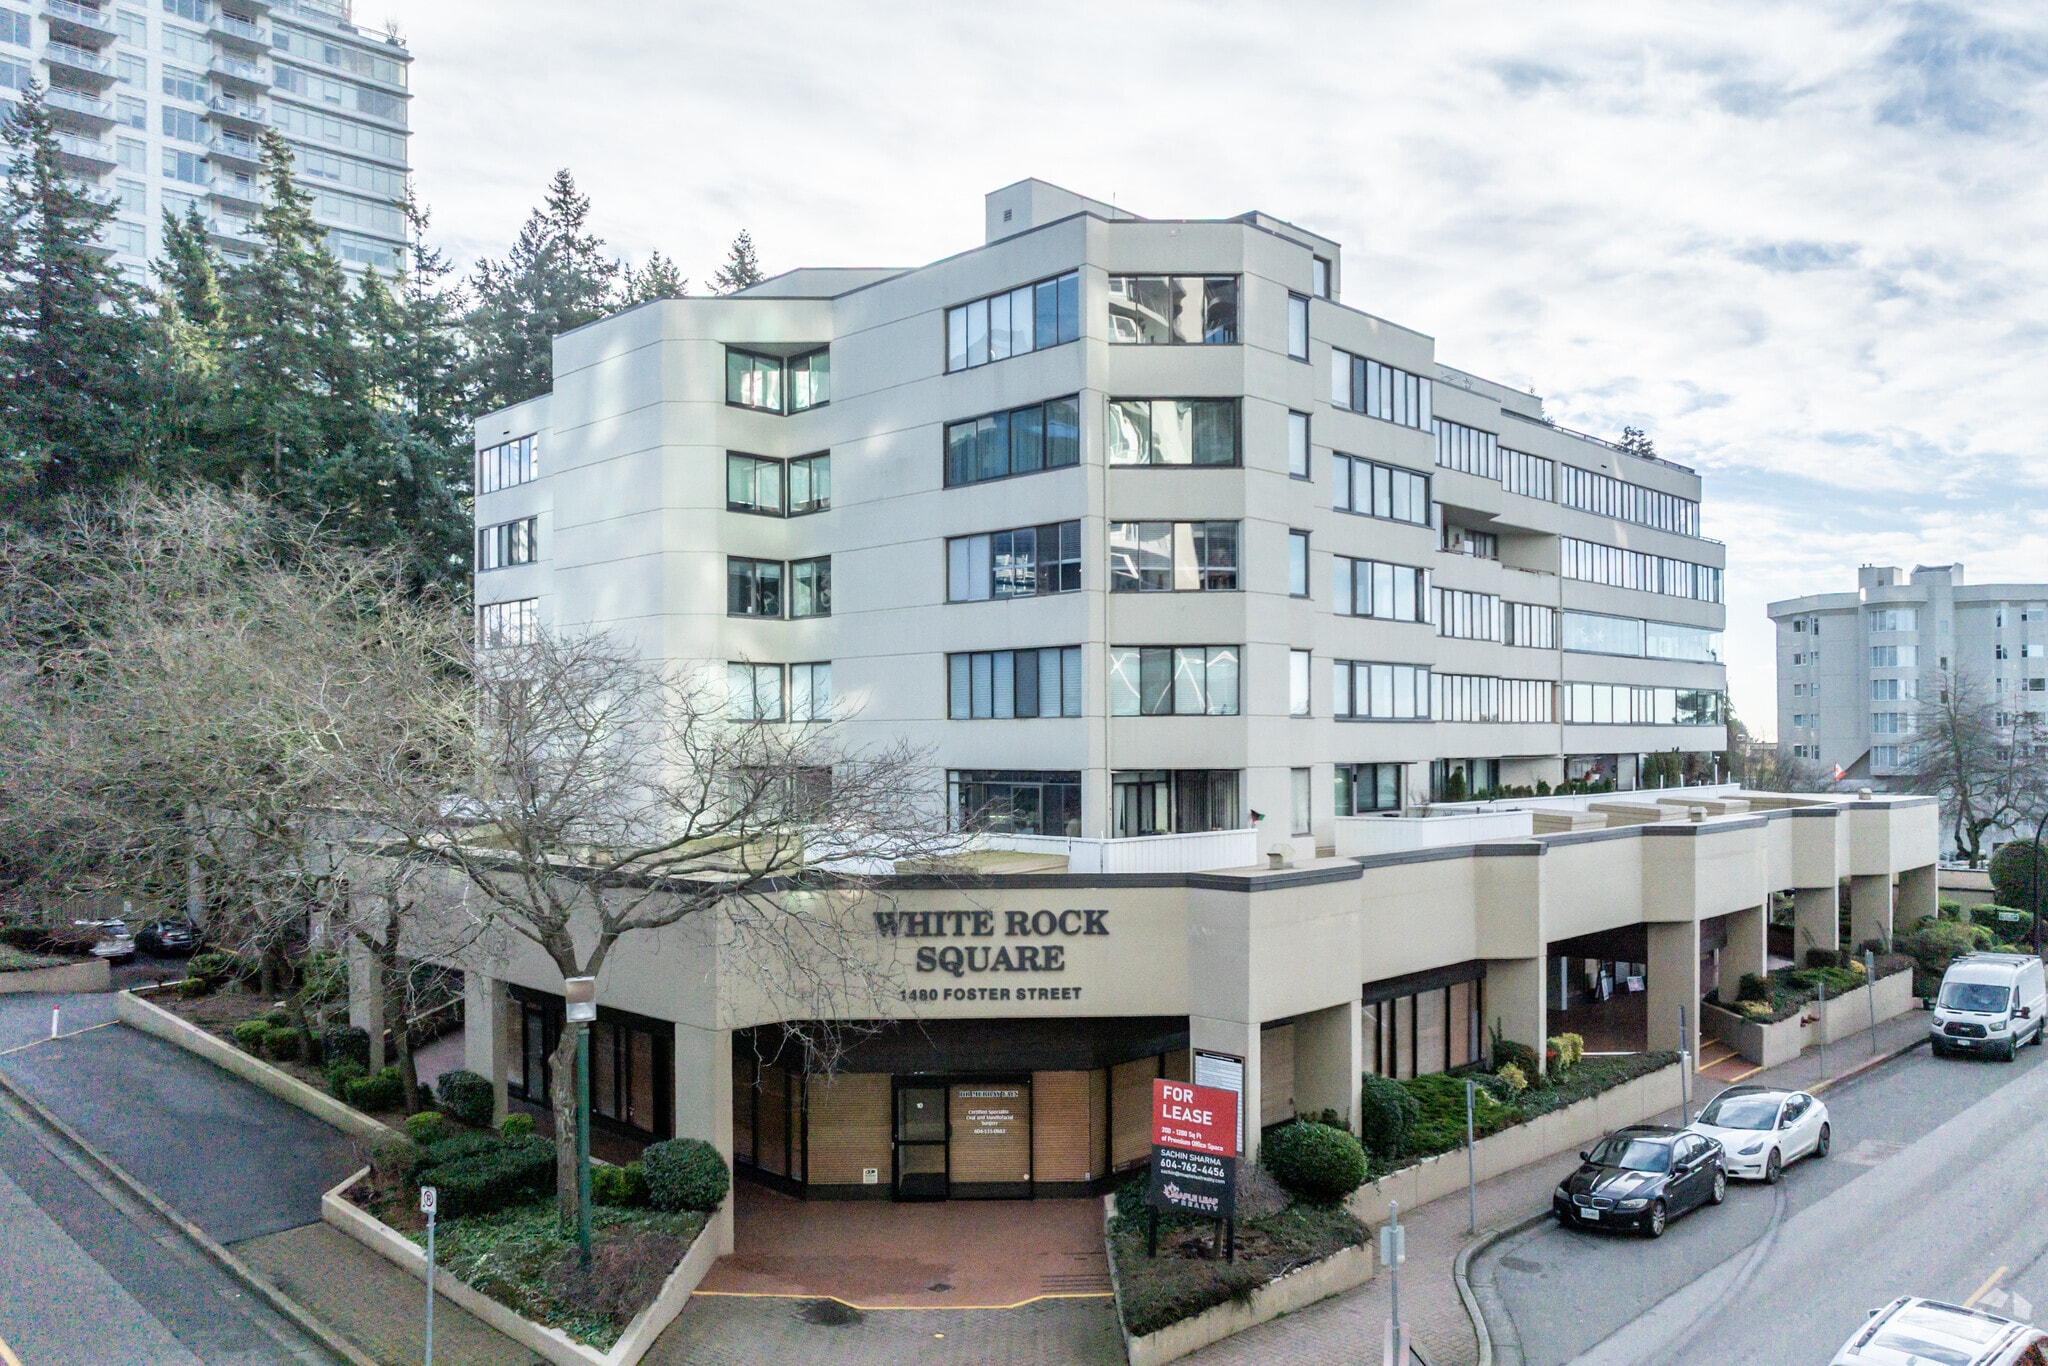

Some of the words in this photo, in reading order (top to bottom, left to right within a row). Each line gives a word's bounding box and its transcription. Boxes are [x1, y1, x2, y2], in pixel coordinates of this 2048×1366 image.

[873, 910, 994, 937] WHITE
[1005, 909, 1109, 936] ROCK
[916, 945, 1065, 977] SQUARE
[900, 988, 938, 1001] 1480
[943, 988, 1011, 1000] FOSTER
[1016, 987, 1082, 1000] STREET
[1163, 1085, 1194, 1104] FOR
[1162, 1104, 1213, 1125] LEASE
[1207, 1143, 1224, 1151] Space
[1160, 1149, 1188, 1160] SACHIN
[1189, 1154, 1221, 1166] SHARMA
[1160, 1158, 1225, 1178] 604-762-4456
[1180, 1200, 1219, 1212] REALTY
